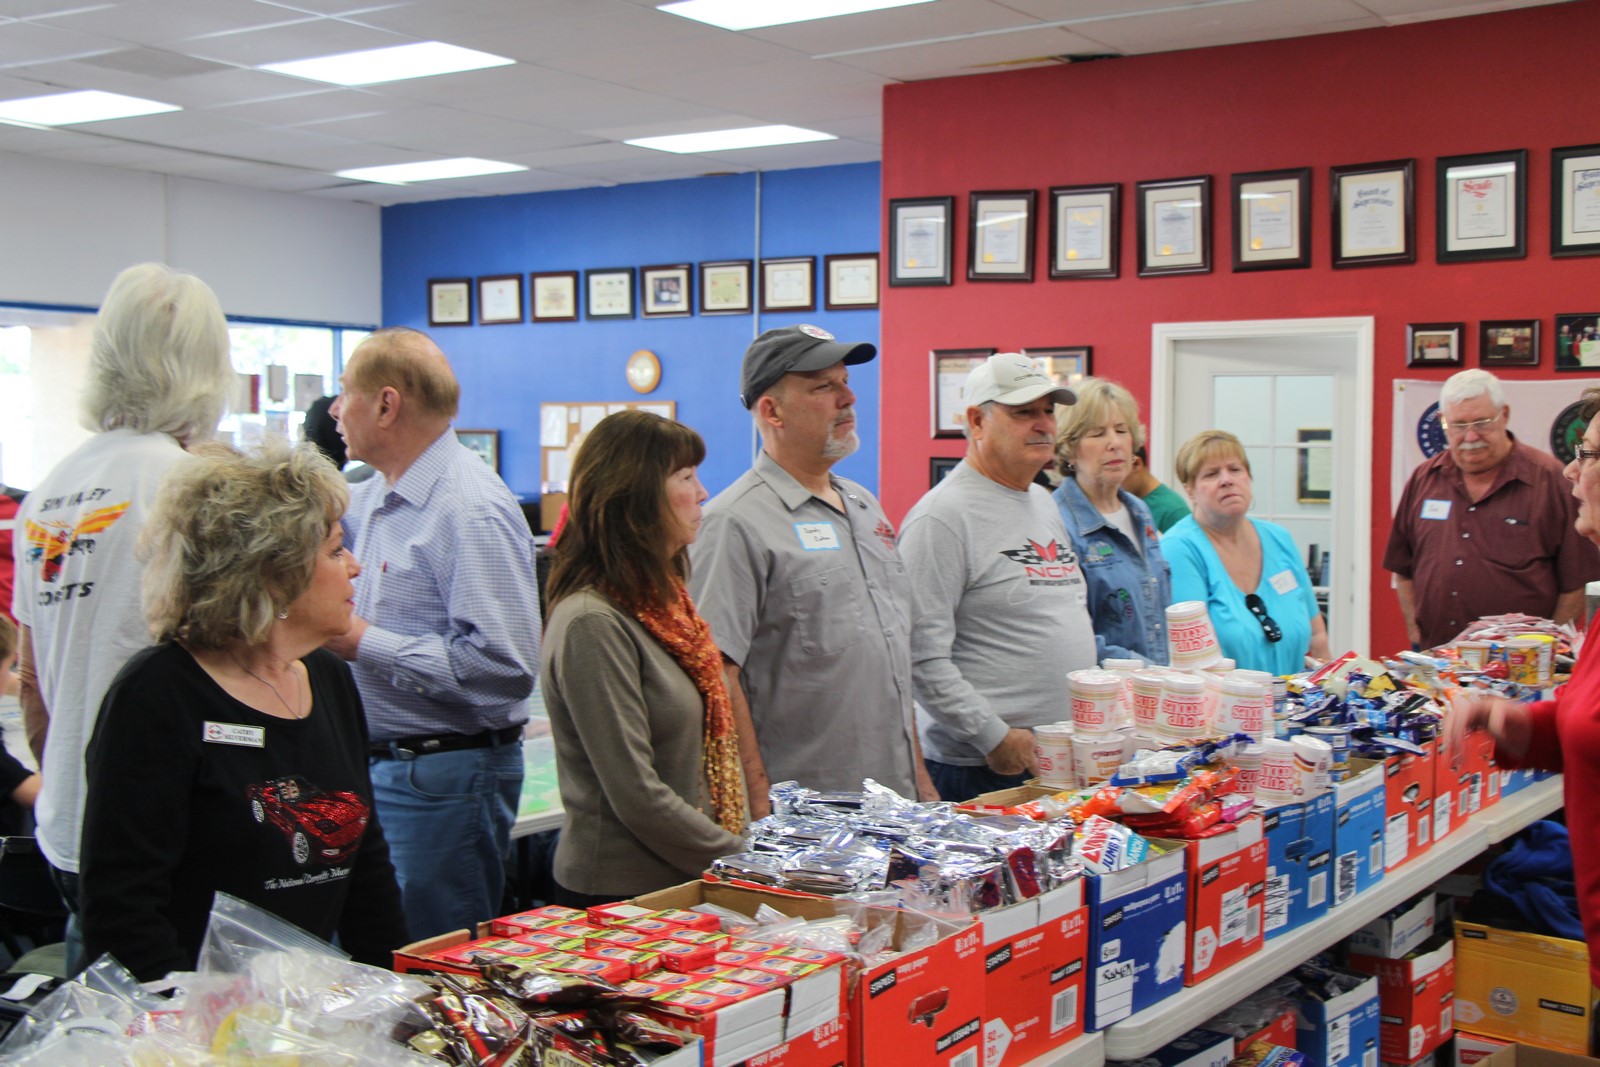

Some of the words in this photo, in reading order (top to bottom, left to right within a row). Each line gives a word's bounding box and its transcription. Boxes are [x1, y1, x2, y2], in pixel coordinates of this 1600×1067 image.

[1025, 566, 1075, 577] NCM
[1168, 715, 1199, 727] CUP
[986, 949, 1011, 969] STAPLES
[870, 972, 896, 994] STAPLES
